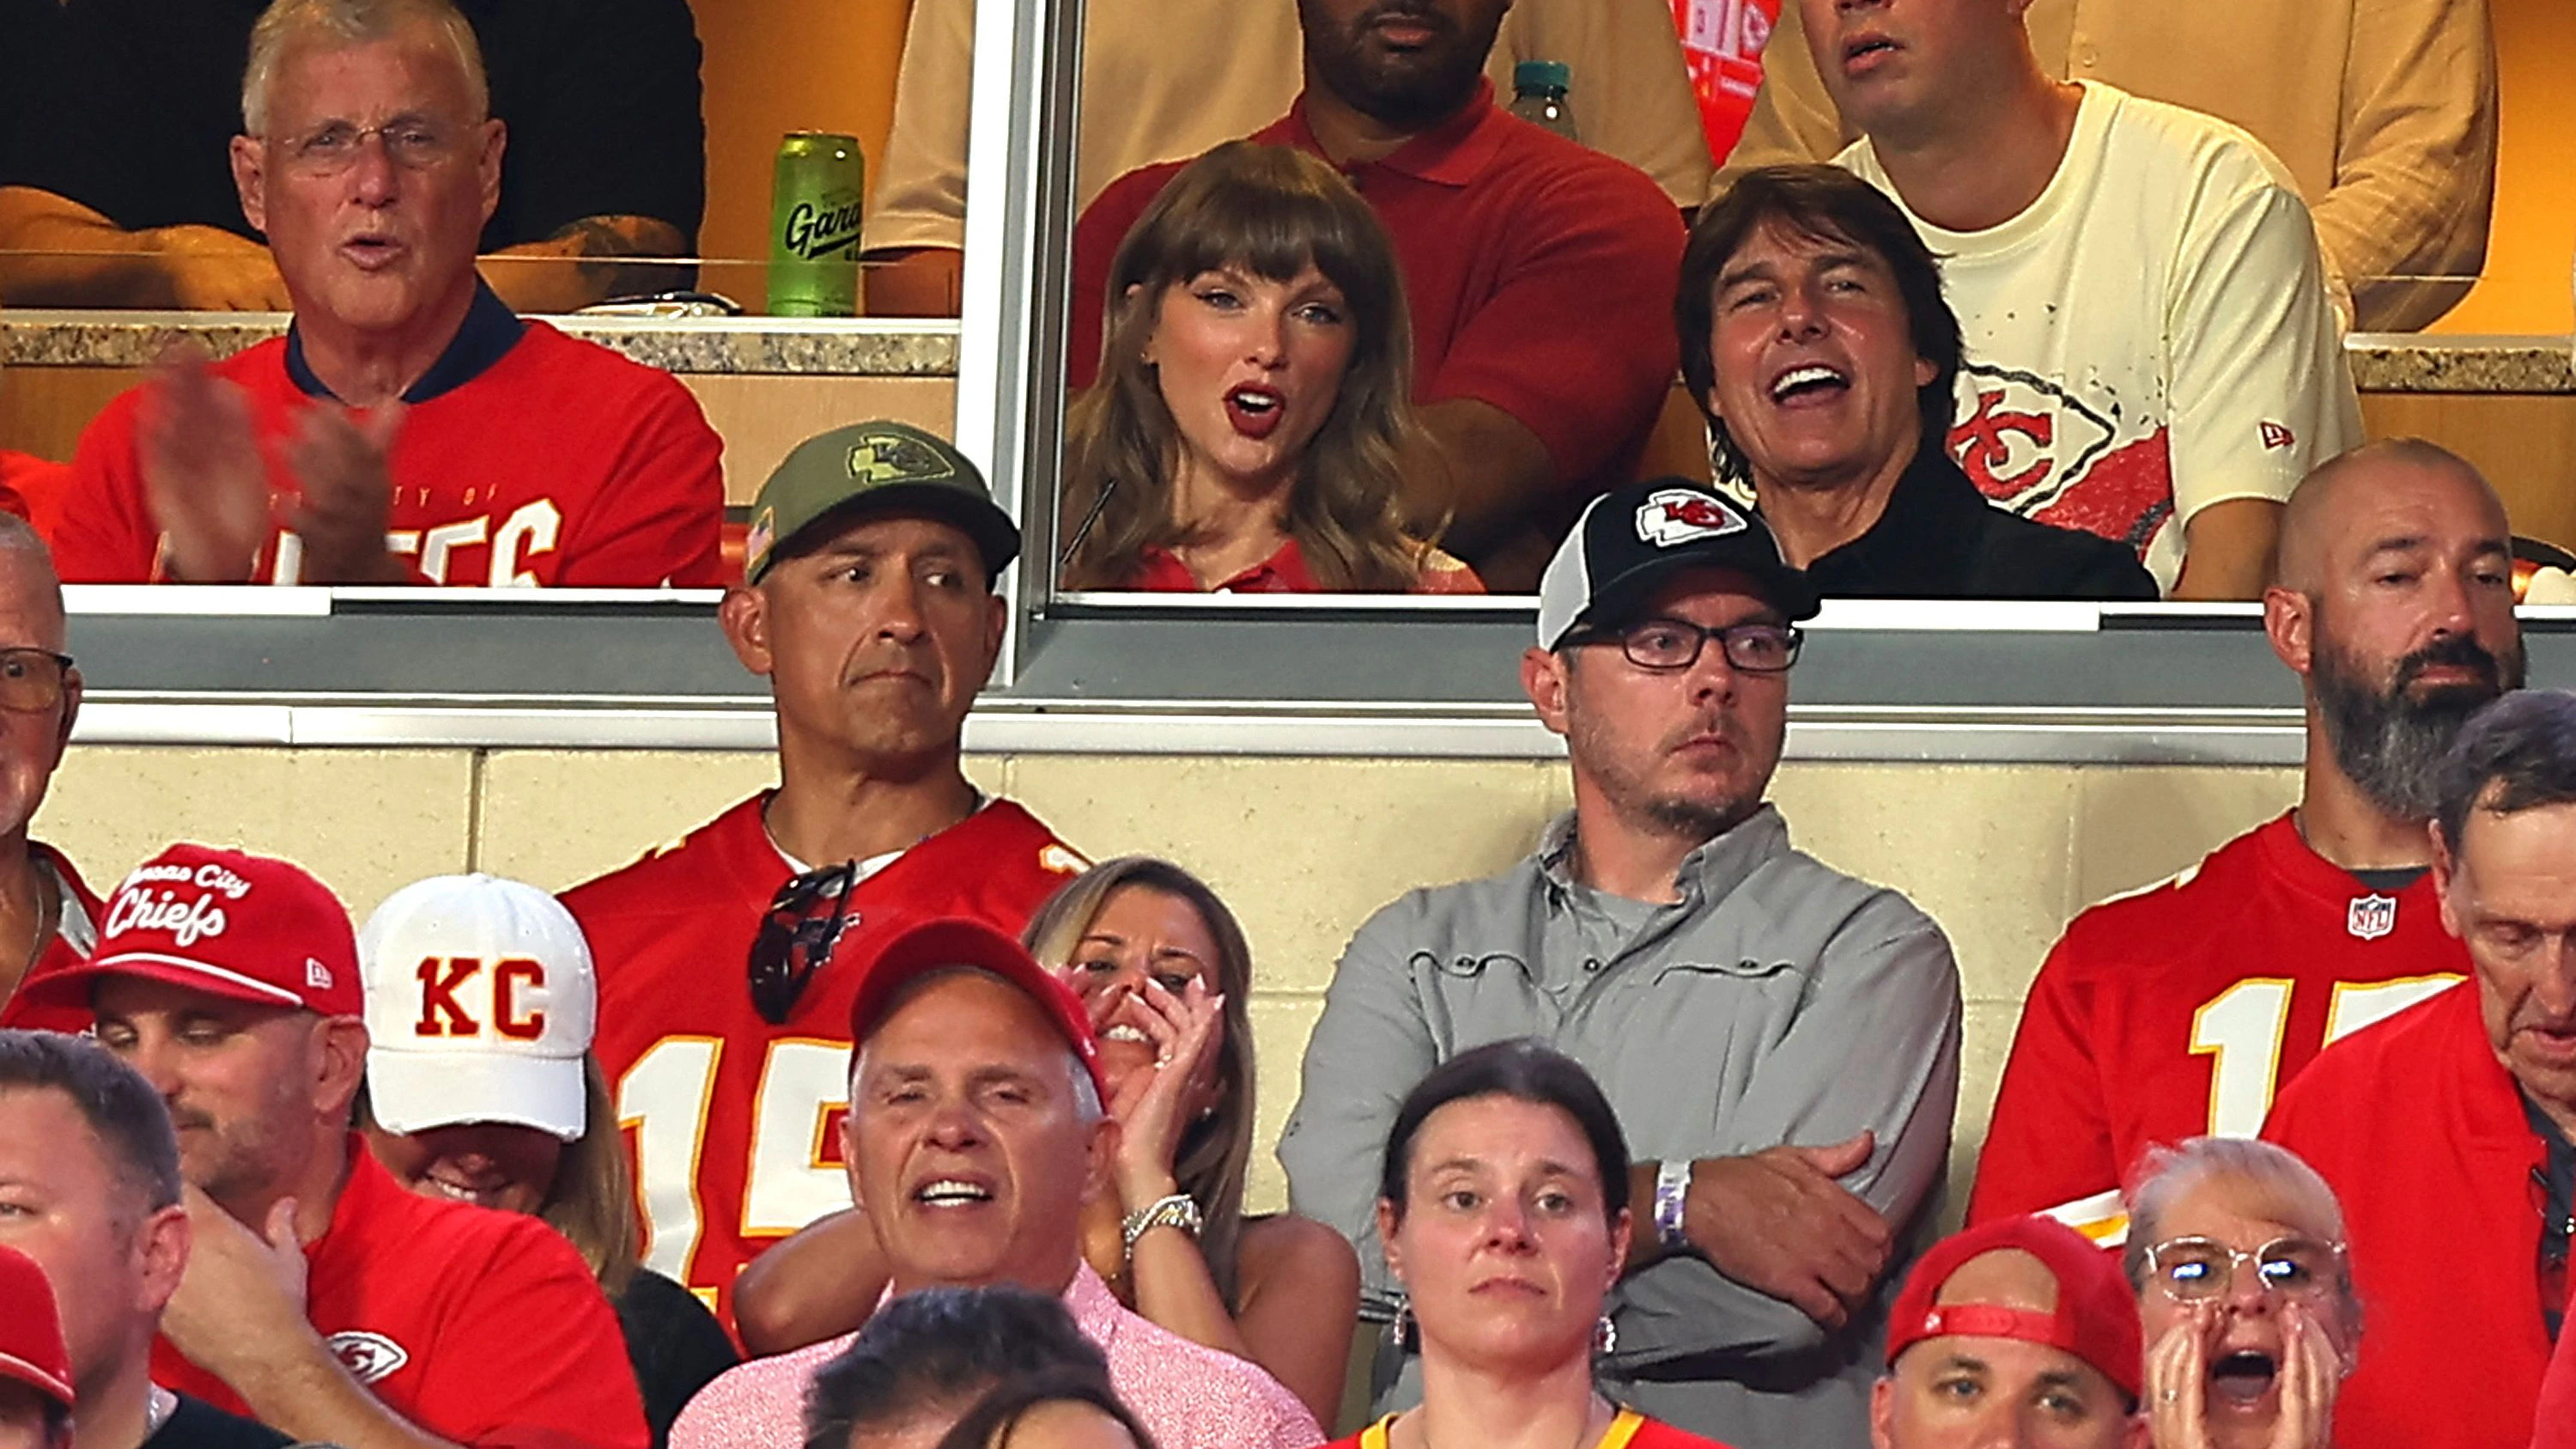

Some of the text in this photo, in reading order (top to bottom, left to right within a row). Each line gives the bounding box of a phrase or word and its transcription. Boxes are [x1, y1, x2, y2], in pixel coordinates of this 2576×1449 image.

[105, 887, 225, 947] Chiefs
[194, 863, 252, 899] City
[415, 956, 547, 1042] KC
[2189, 971, 2470, 1140] 1
